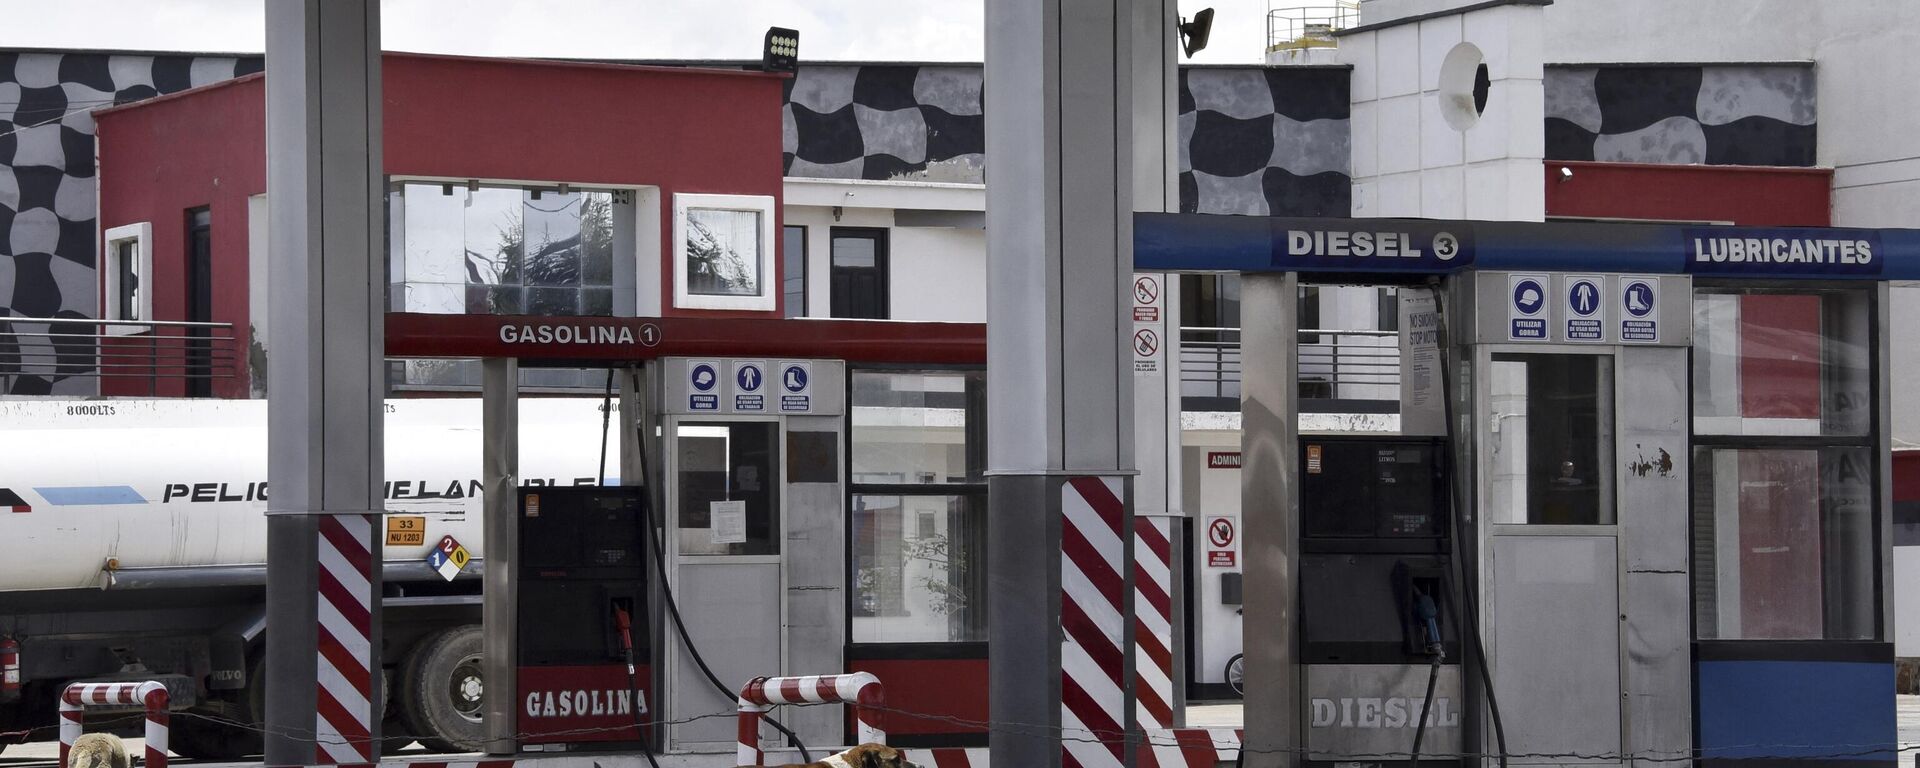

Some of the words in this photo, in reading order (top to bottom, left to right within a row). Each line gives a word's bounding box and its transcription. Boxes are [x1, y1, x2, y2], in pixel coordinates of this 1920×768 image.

[1288, 230, 1421, 257] DIESEL
[1695, 238, 1872, 264] LUBRICANTES
[500, 325, 635, 344] GASOLINA
[400, 520, 413, 528] 33
[391, 533, 401, 541] NU
[404, 533, 420, 541] 1203
[444, 538, 452, 552] 2
[433, 552, 440, 567] 1
[456, 550, 464, 563] 0
[526, 690, 648, 716] GASOLINA
[1312, 697, 1458, 728] DIESEL
